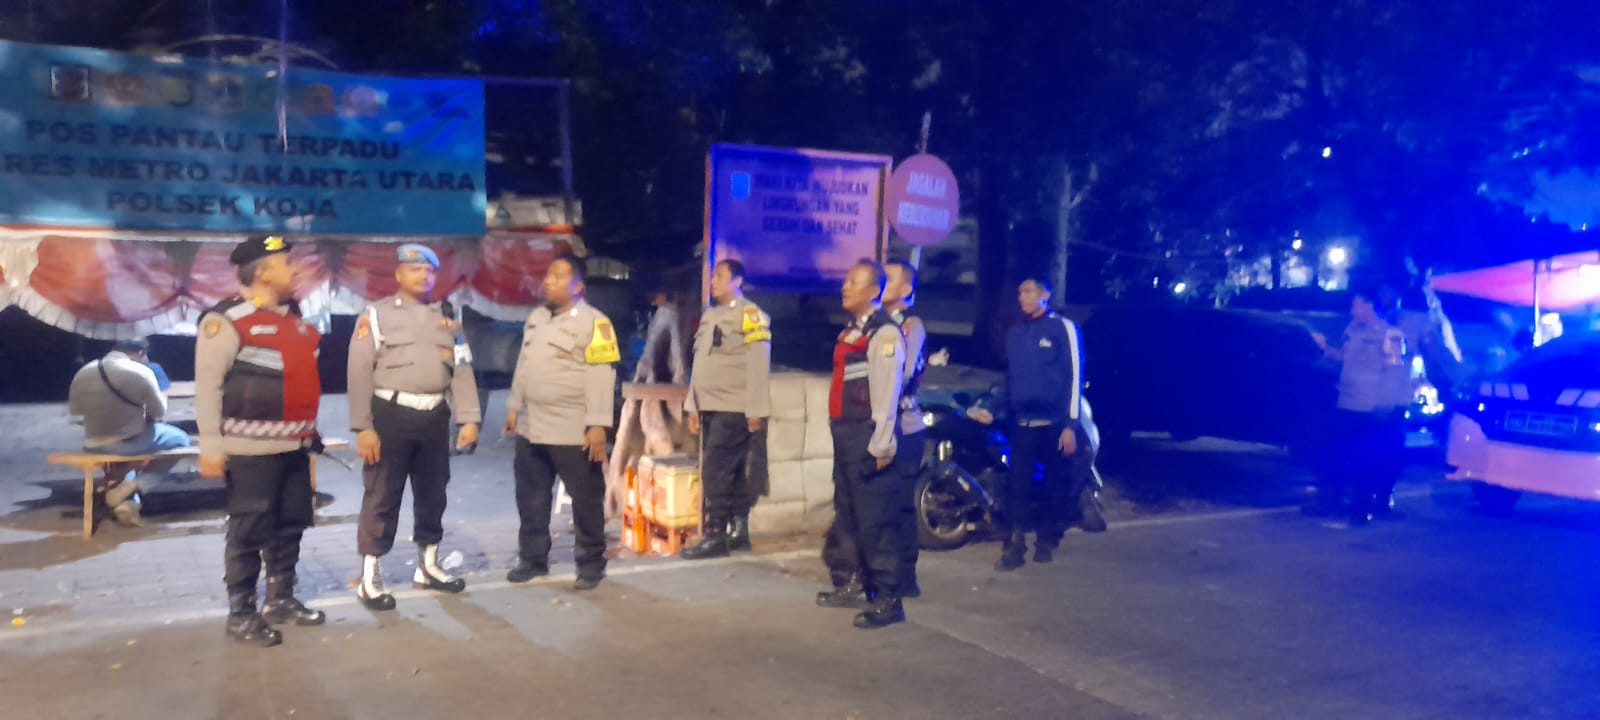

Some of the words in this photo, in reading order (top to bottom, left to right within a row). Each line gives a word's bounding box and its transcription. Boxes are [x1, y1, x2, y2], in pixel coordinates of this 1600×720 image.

[25, 119, 98, 145] POS
[110, 124, 247, 153] PANTAU
[258, 133, 400, 160] TERPADU
[88, 157, 210, 182] METRO
[222, 162, 370, 190] JAKARTA
[378, 170, 475, 192] UTARA
[106, 191, 240, 217] POLSEK
[253, 197, 337, 218] KOJA
[833, 201, 860, 216] YANG
[826, 219, 858, 236] SEHAT
